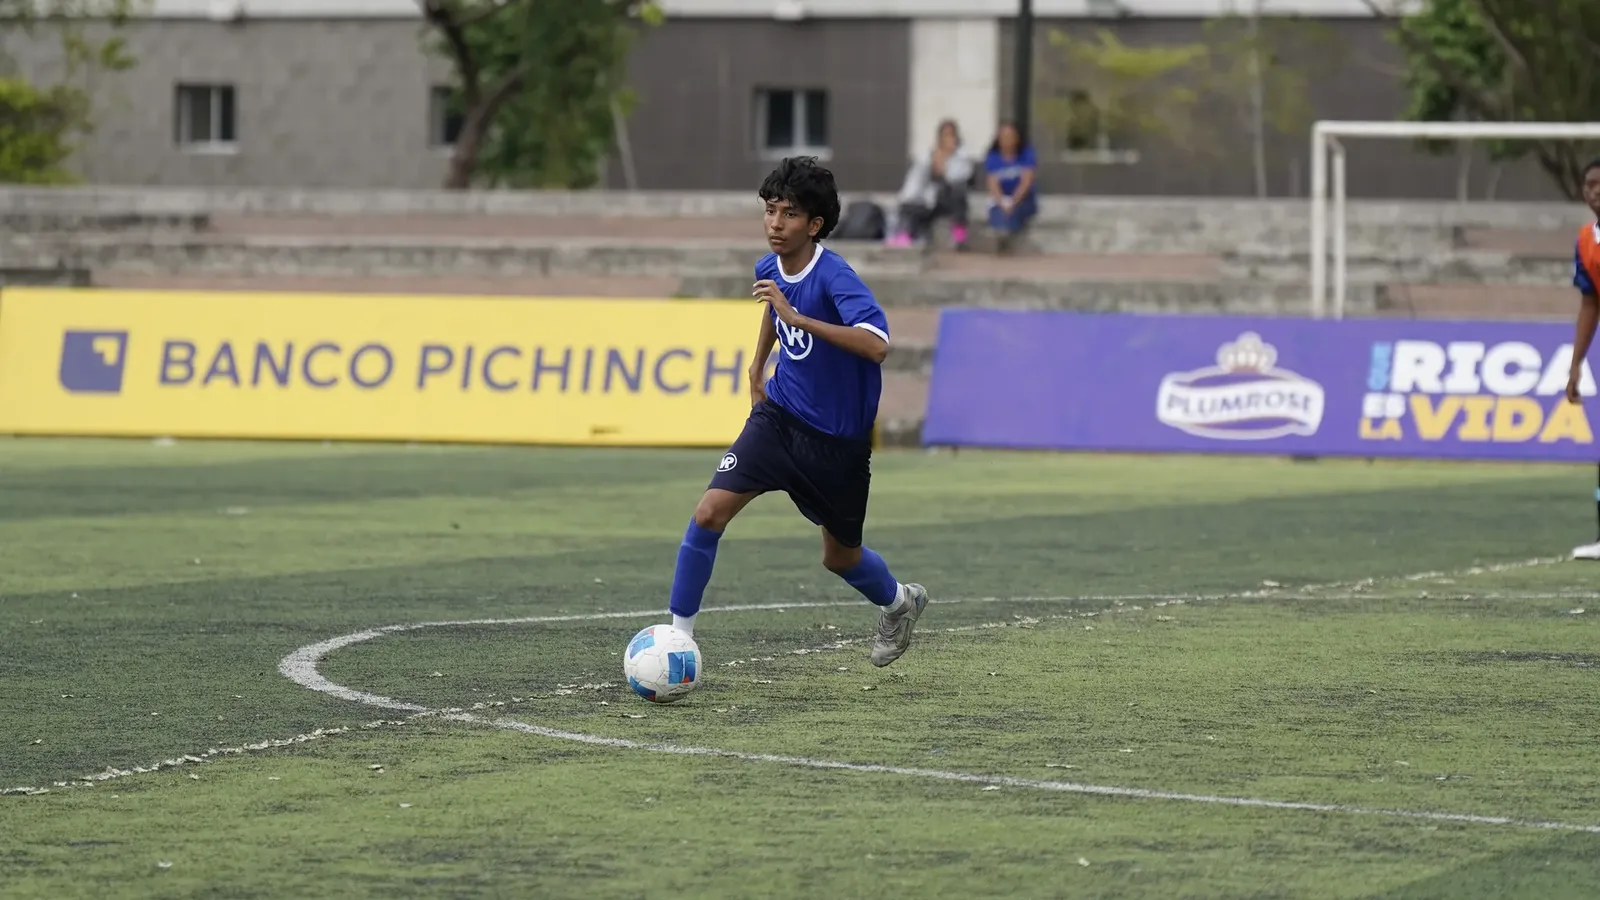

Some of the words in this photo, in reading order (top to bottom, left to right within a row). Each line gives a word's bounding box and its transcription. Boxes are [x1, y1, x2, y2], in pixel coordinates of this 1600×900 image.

[158, 339, 395, 389] BANCO
[415, 343, 780, 396] PICHINCH
[1391, 339, 1598, 397] RICA
[1165, 391, 1313, 416] PLUMROSE
[1358, 417, 1403, 440] LA
[1409, 393, 1594, 444] VIDA
